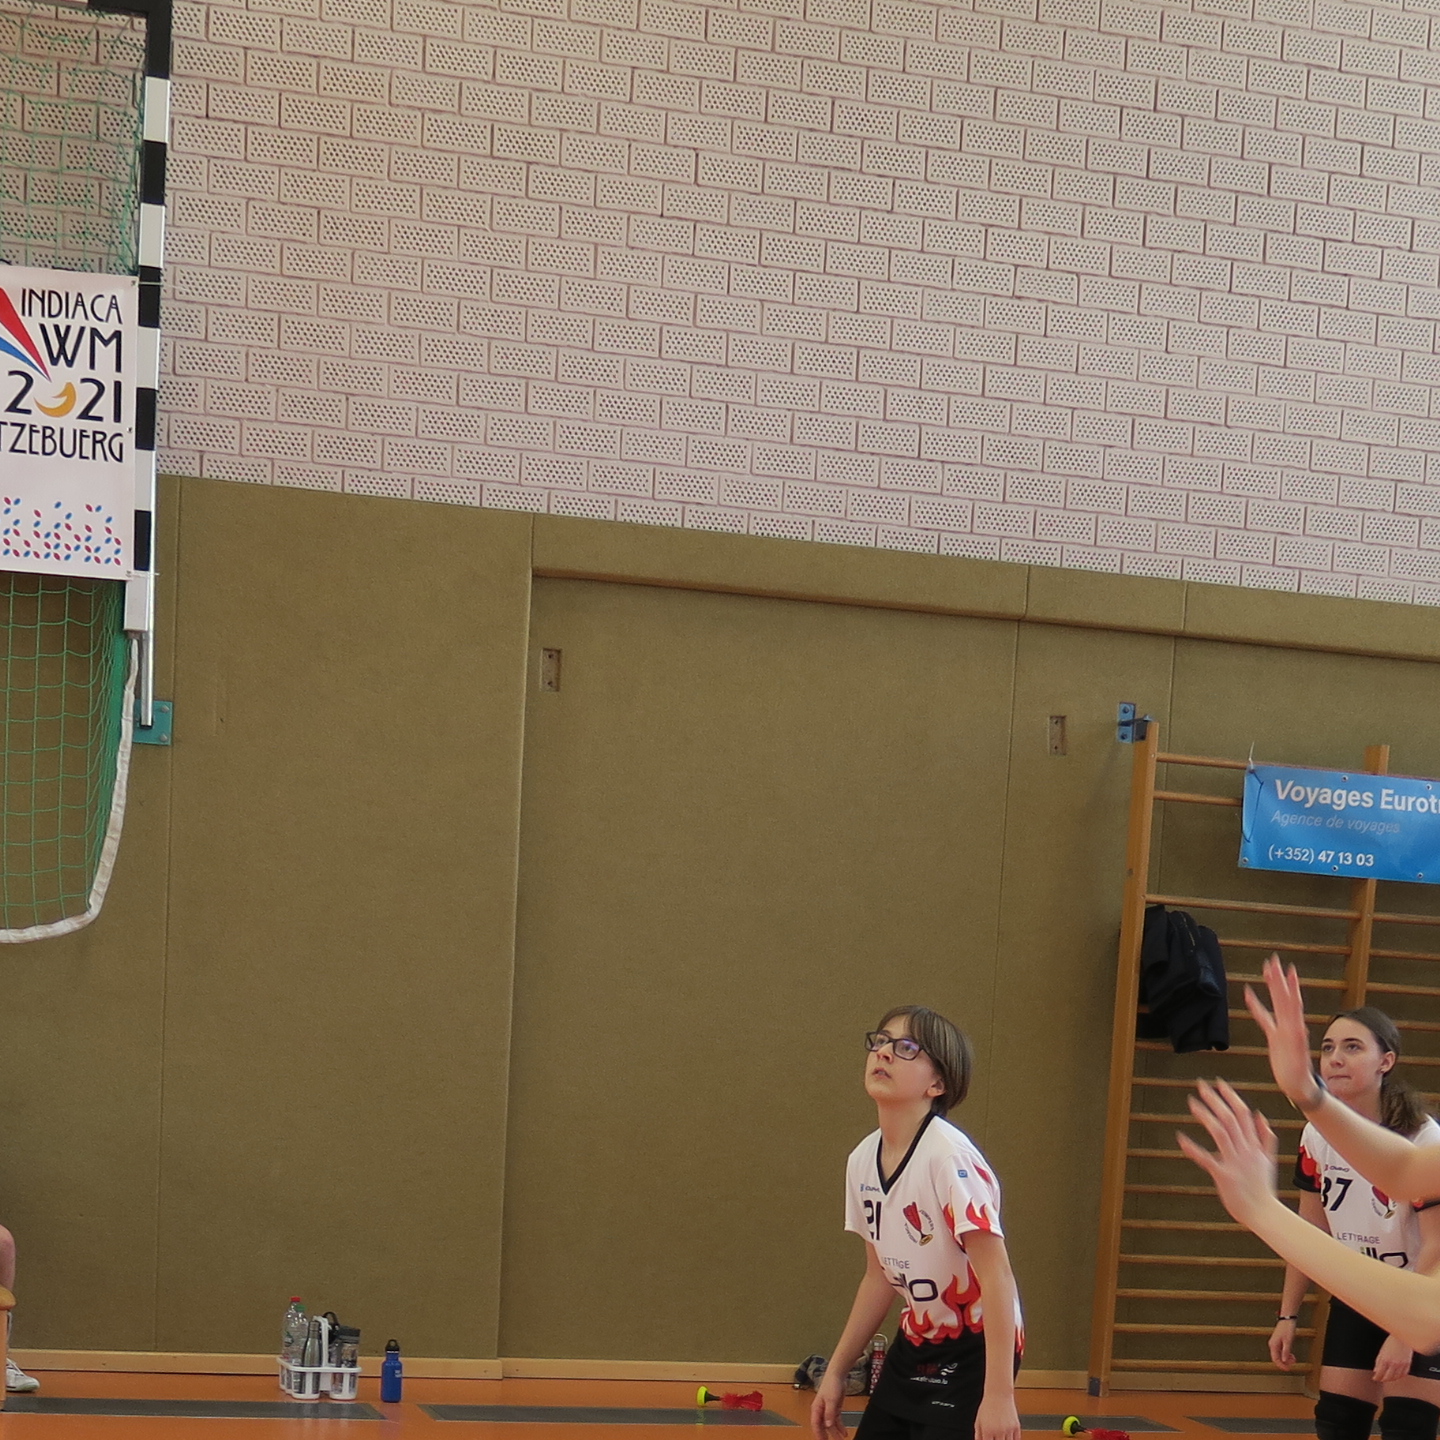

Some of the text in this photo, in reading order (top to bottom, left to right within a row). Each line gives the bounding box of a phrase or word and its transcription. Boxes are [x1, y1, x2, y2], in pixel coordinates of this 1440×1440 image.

[21, 287, 123, 325] INDIACA
[39, 322, 123, 373] WM
[1275, 779, 1374, 811] Voyages
[1270, 809, 1400, 836] Agence de voyages
[1268, 843, 1375, 867] (+352) 47 13 03
[1336, 1231, 1381, 1245] LETTRAGE
